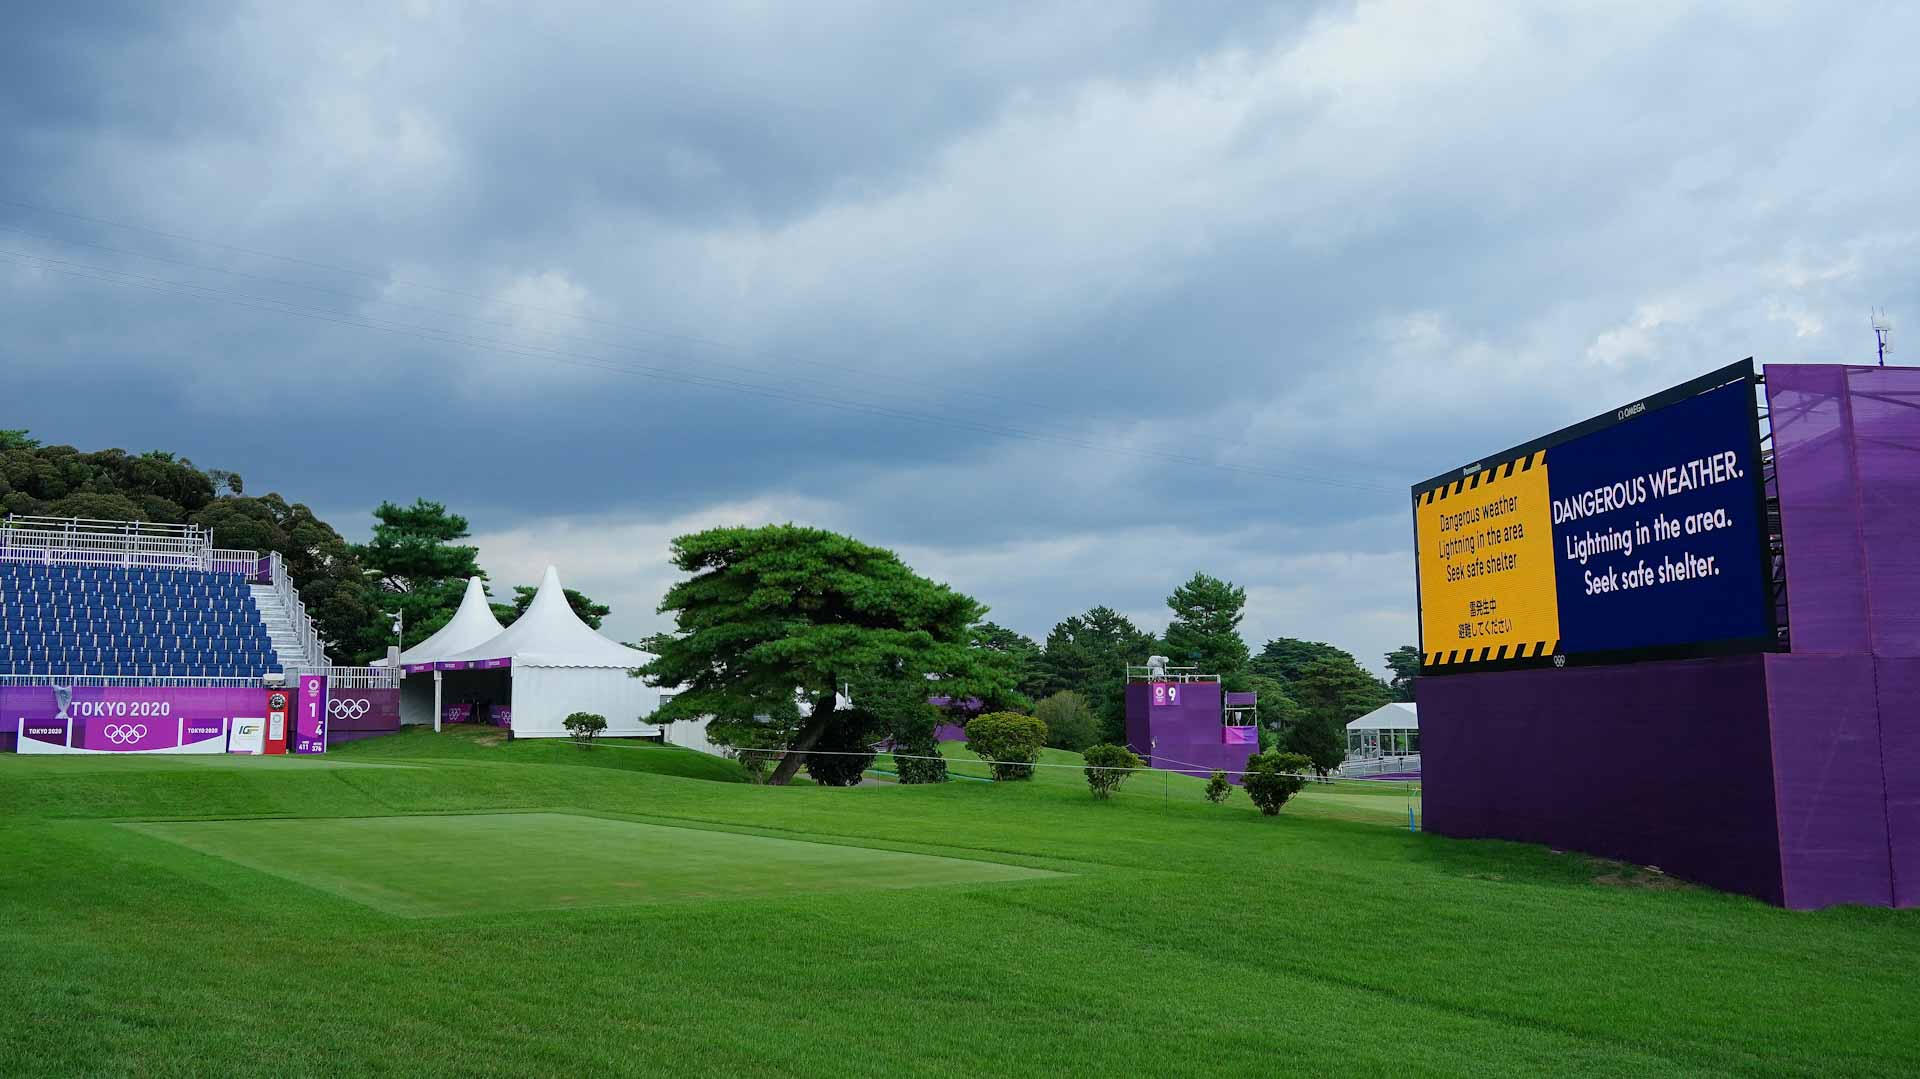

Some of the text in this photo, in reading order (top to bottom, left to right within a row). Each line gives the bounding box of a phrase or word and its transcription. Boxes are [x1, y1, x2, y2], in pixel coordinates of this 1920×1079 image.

[1624, 402, 1646, 417] OMEGA
[1553, 450, 1744, 524] DANGEROUS WEATHER.
[1440, 495, 1518, 532] Dangerous weather
[1439, 523, 1524, 560] Lightning in the area
[1566, 508, 1733, 565] Lightning in the area.
[1446, 552, 1517, 582] Seek safe shelter
[1584, 551, 1720, 595] Seek safe shelter.
[1168, 687, 1177, 701] 9
[71, 701, 170, 717] TOKYO 2020
[308, 702, 316, 718] 1
[315, 724, 323, 736] 4
[298, 743, 309, 751] 411
